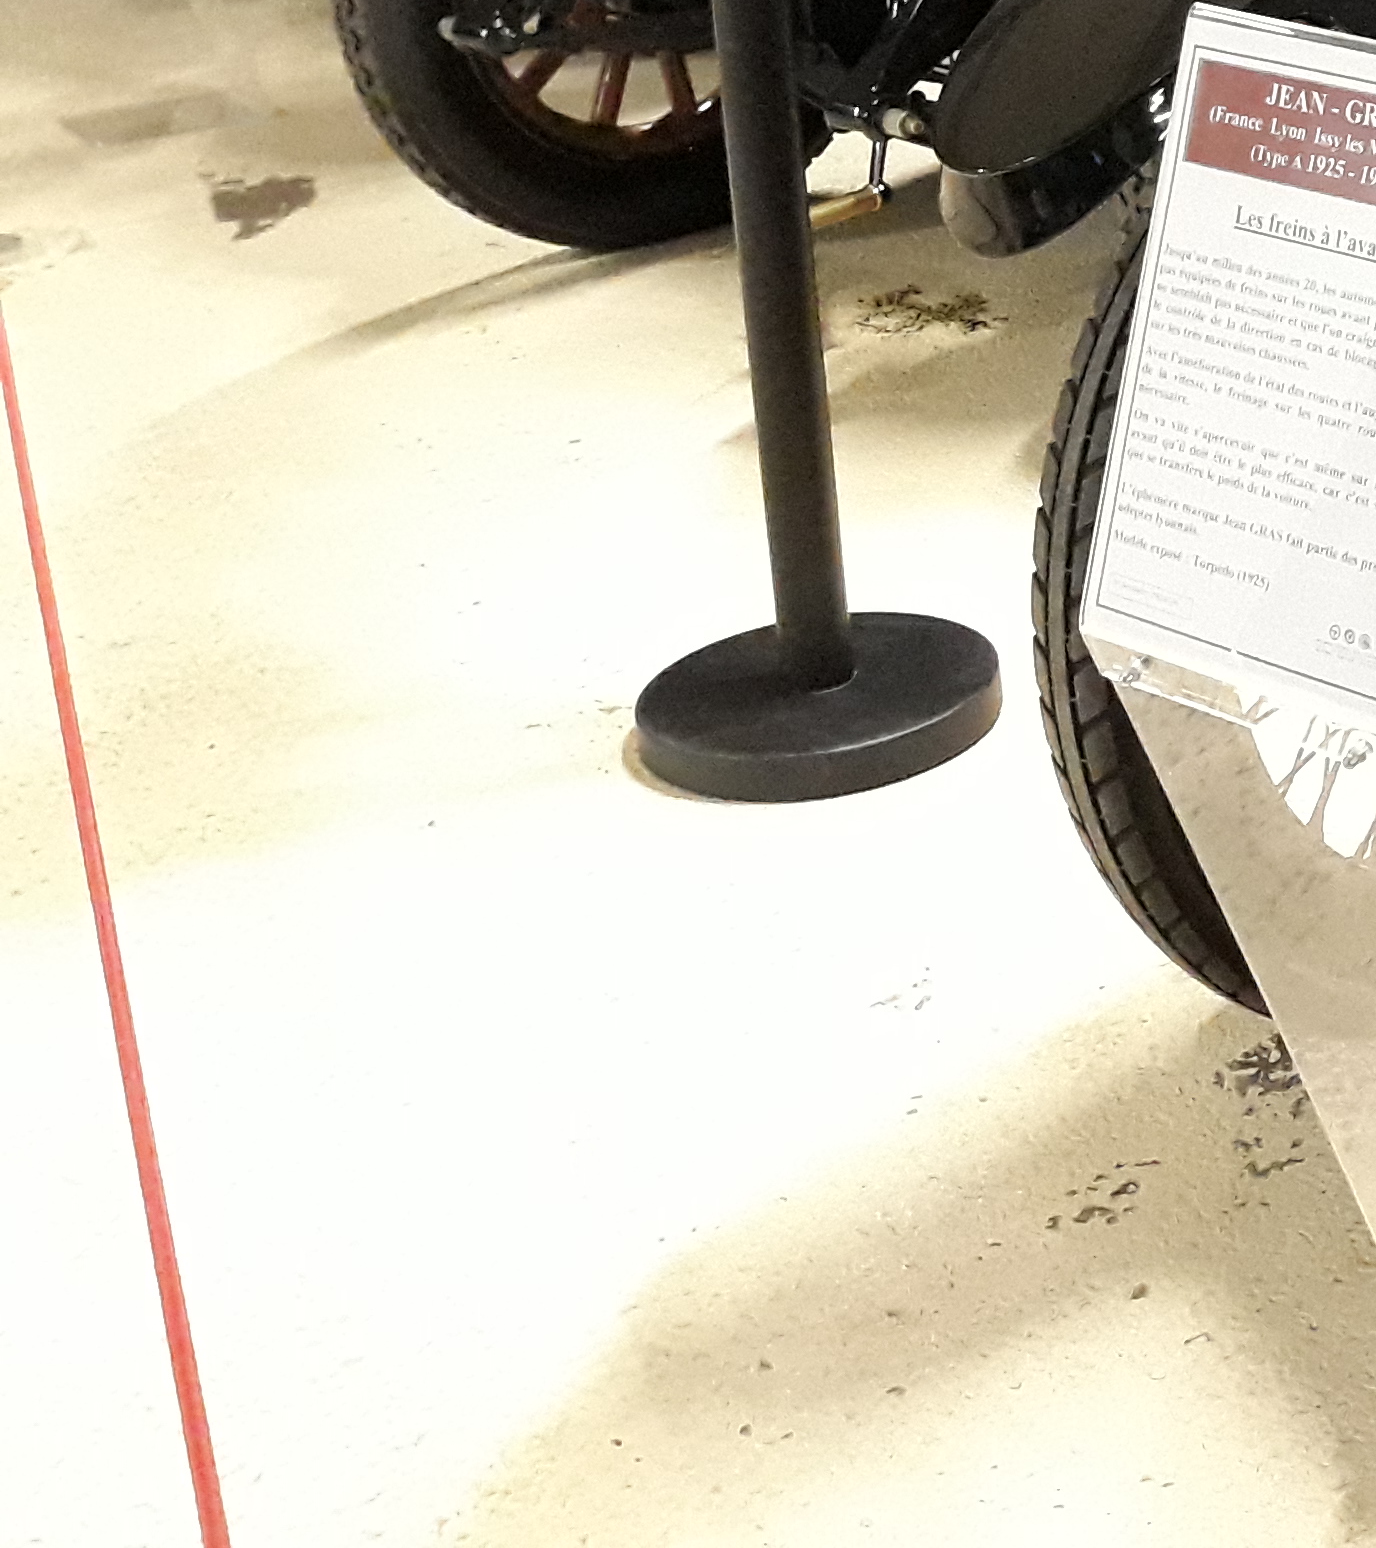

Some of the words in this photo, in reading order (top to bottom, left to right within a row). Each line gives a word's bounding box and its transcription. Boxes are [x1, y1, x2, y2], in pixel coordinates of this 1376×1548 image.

[1265, 81, 1328, 117] JEAN
[1208, 104, 1263, 132] (France
[1270, 118, 1307, 142] Lyon
[1314, 127, 1342, 153] Issy
[1345, 134, 1364, 155] les
[1250, 141, 1289, 168] (Type
[1306, 153, 1347, 180] 1925
[1235, 205, 1264, 229] Les
[1268, 213, 1317, 242] freins
[1320, 225, 1331, 245] à
